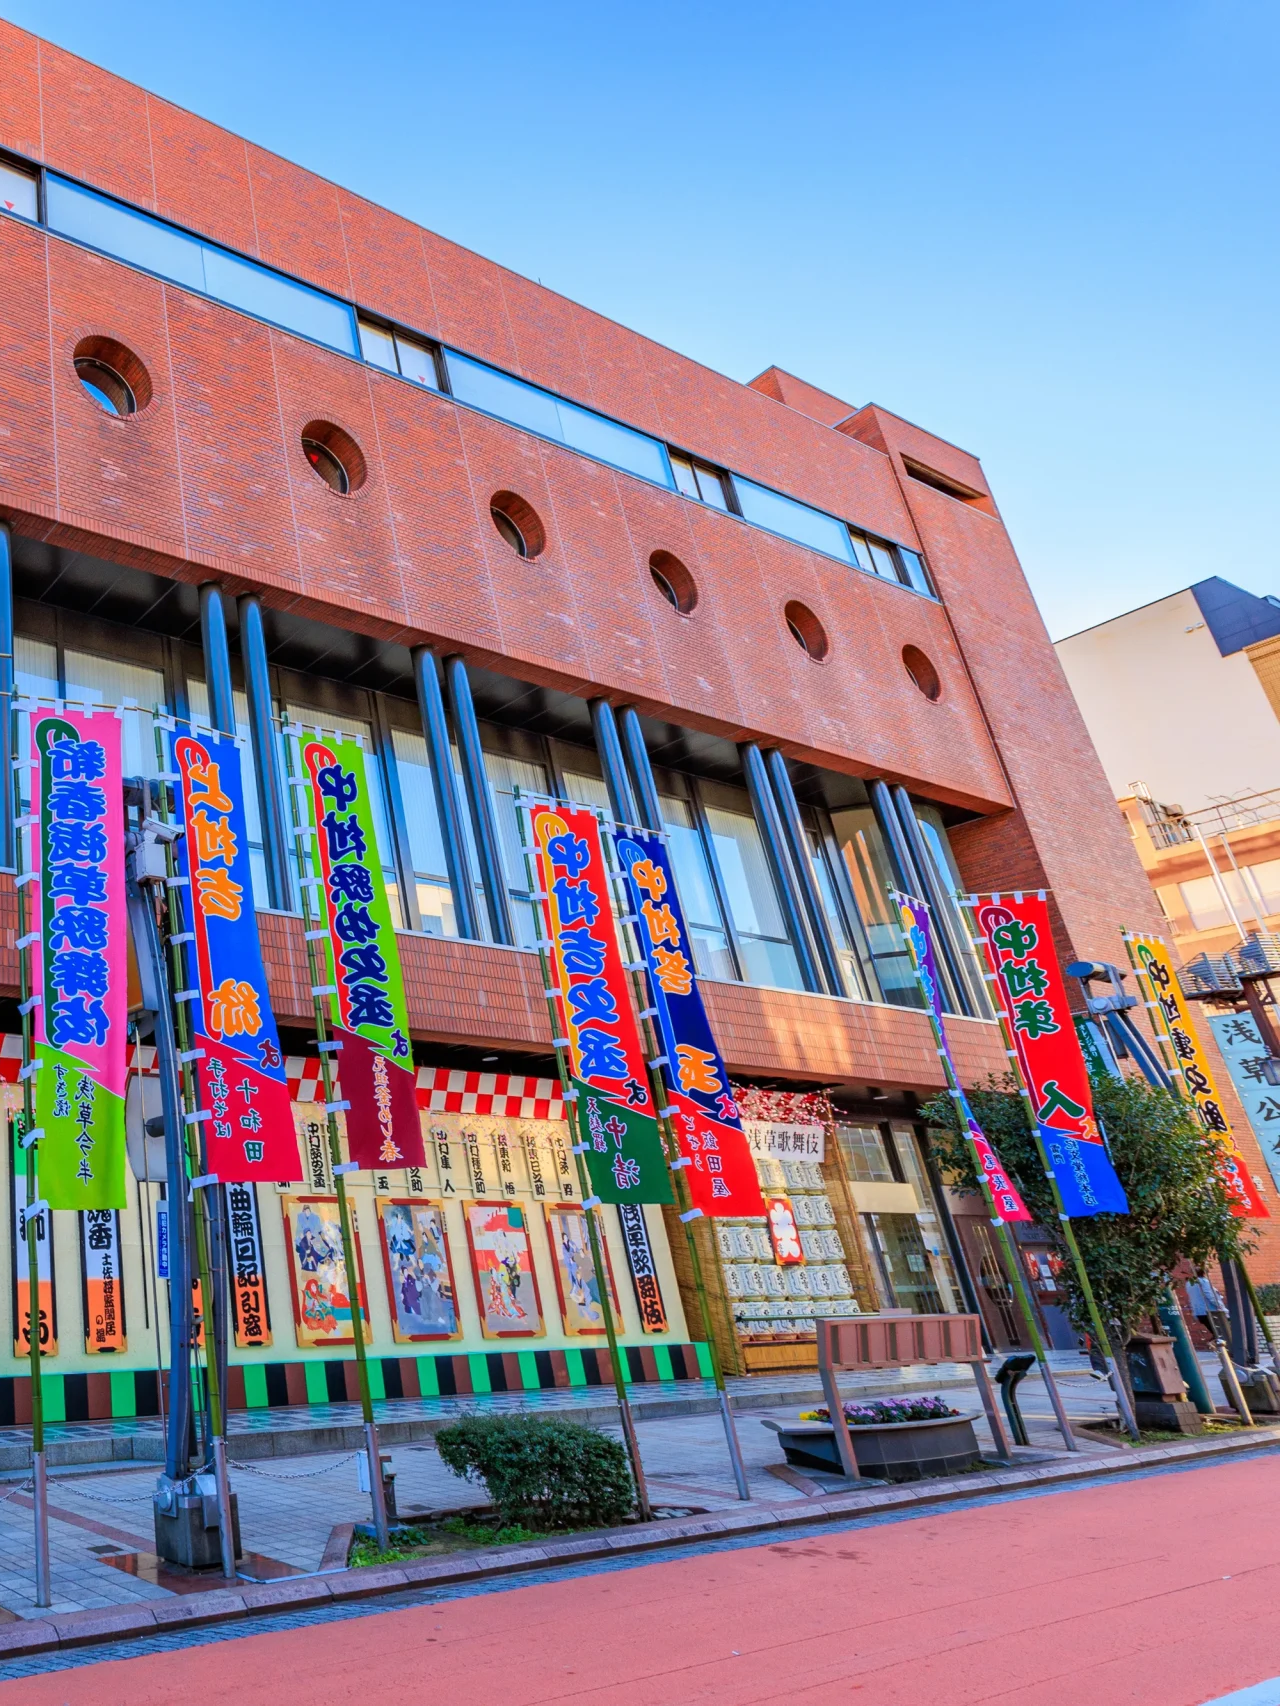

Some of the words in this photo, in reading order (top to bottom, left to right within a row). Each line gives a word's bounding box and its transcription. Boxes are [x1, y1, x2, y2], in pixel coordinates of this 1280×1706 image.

[748, 1128, 819, 1155] 浅草歌舞伎
